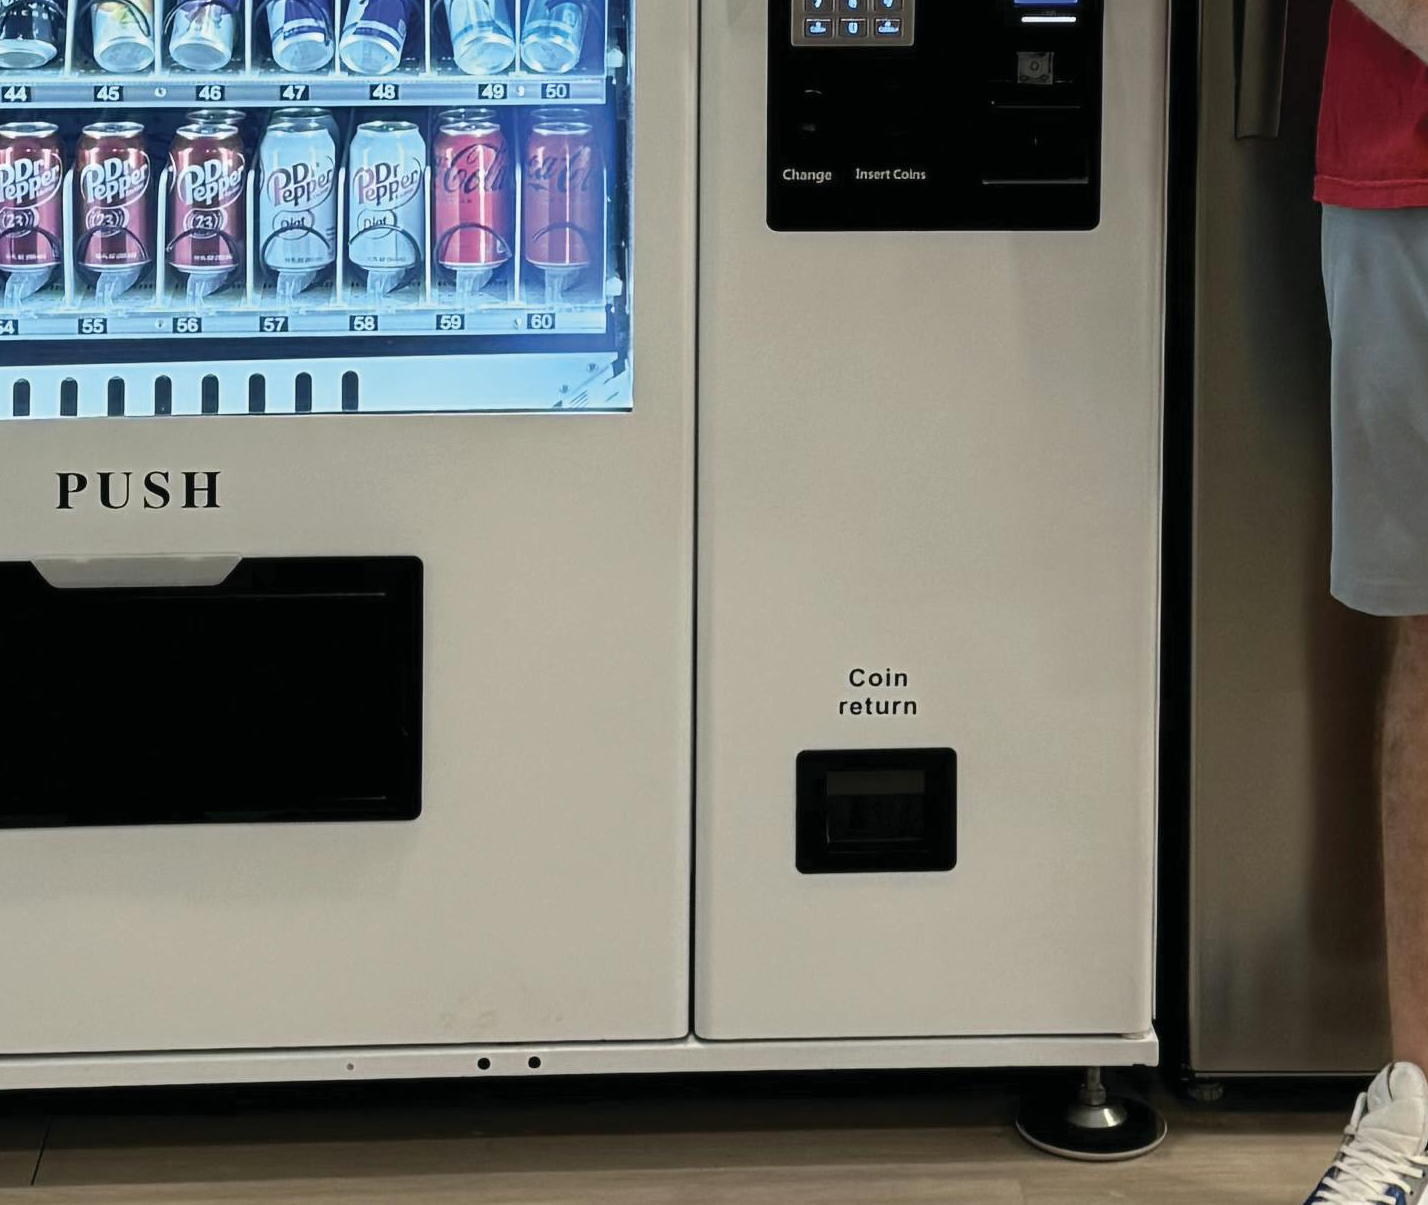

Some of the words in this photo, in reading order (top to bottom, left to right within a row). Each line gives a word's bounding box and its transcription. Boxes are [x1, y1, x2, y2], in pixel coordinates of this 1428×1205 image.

[848, 22, 858, 34] 0
[3, 86, 28, 103] 44
[96, 85, 120, 102] 45
[198, 84, 222, 102] 46
[282, 84, 307, 101] 47
[372, 83, 397, 101] 48
[481, 83, 505, 101] 49
[544, 83, 568, 100] 50
[14, 158, 44, 181] Dr
[104, 158, 133, 180] Dr
[204, 158, 232, 181] Dr
[375, 162, 401, 181] Dr
[782, 167, 833, 184] Change
[855, 167, 891, 180] Insert
[893, 168, 927, 180] Coins
[83, 164, 148, 204] Pepper
[180, 165, 244, 205] Pepper
[272, 166, 334, 206] Pepper
[357, 166, 419, 206] Pepper
[6, 212, 24, 227] 23
[195, 214, 213, 227] 23
[81, 318, 104, 335] 55
[176, 317, 200, 334] 56
[263, 316, 286, 333] 57
[352, 315, 376, 332] 58
[439, 314, 462, 331] 59
[530, 313, 553, 330] 60
[54, 471, 222, 512] PUSH
[847, 667, 908, 689] Coin
[838, 695, 918, 718] return
